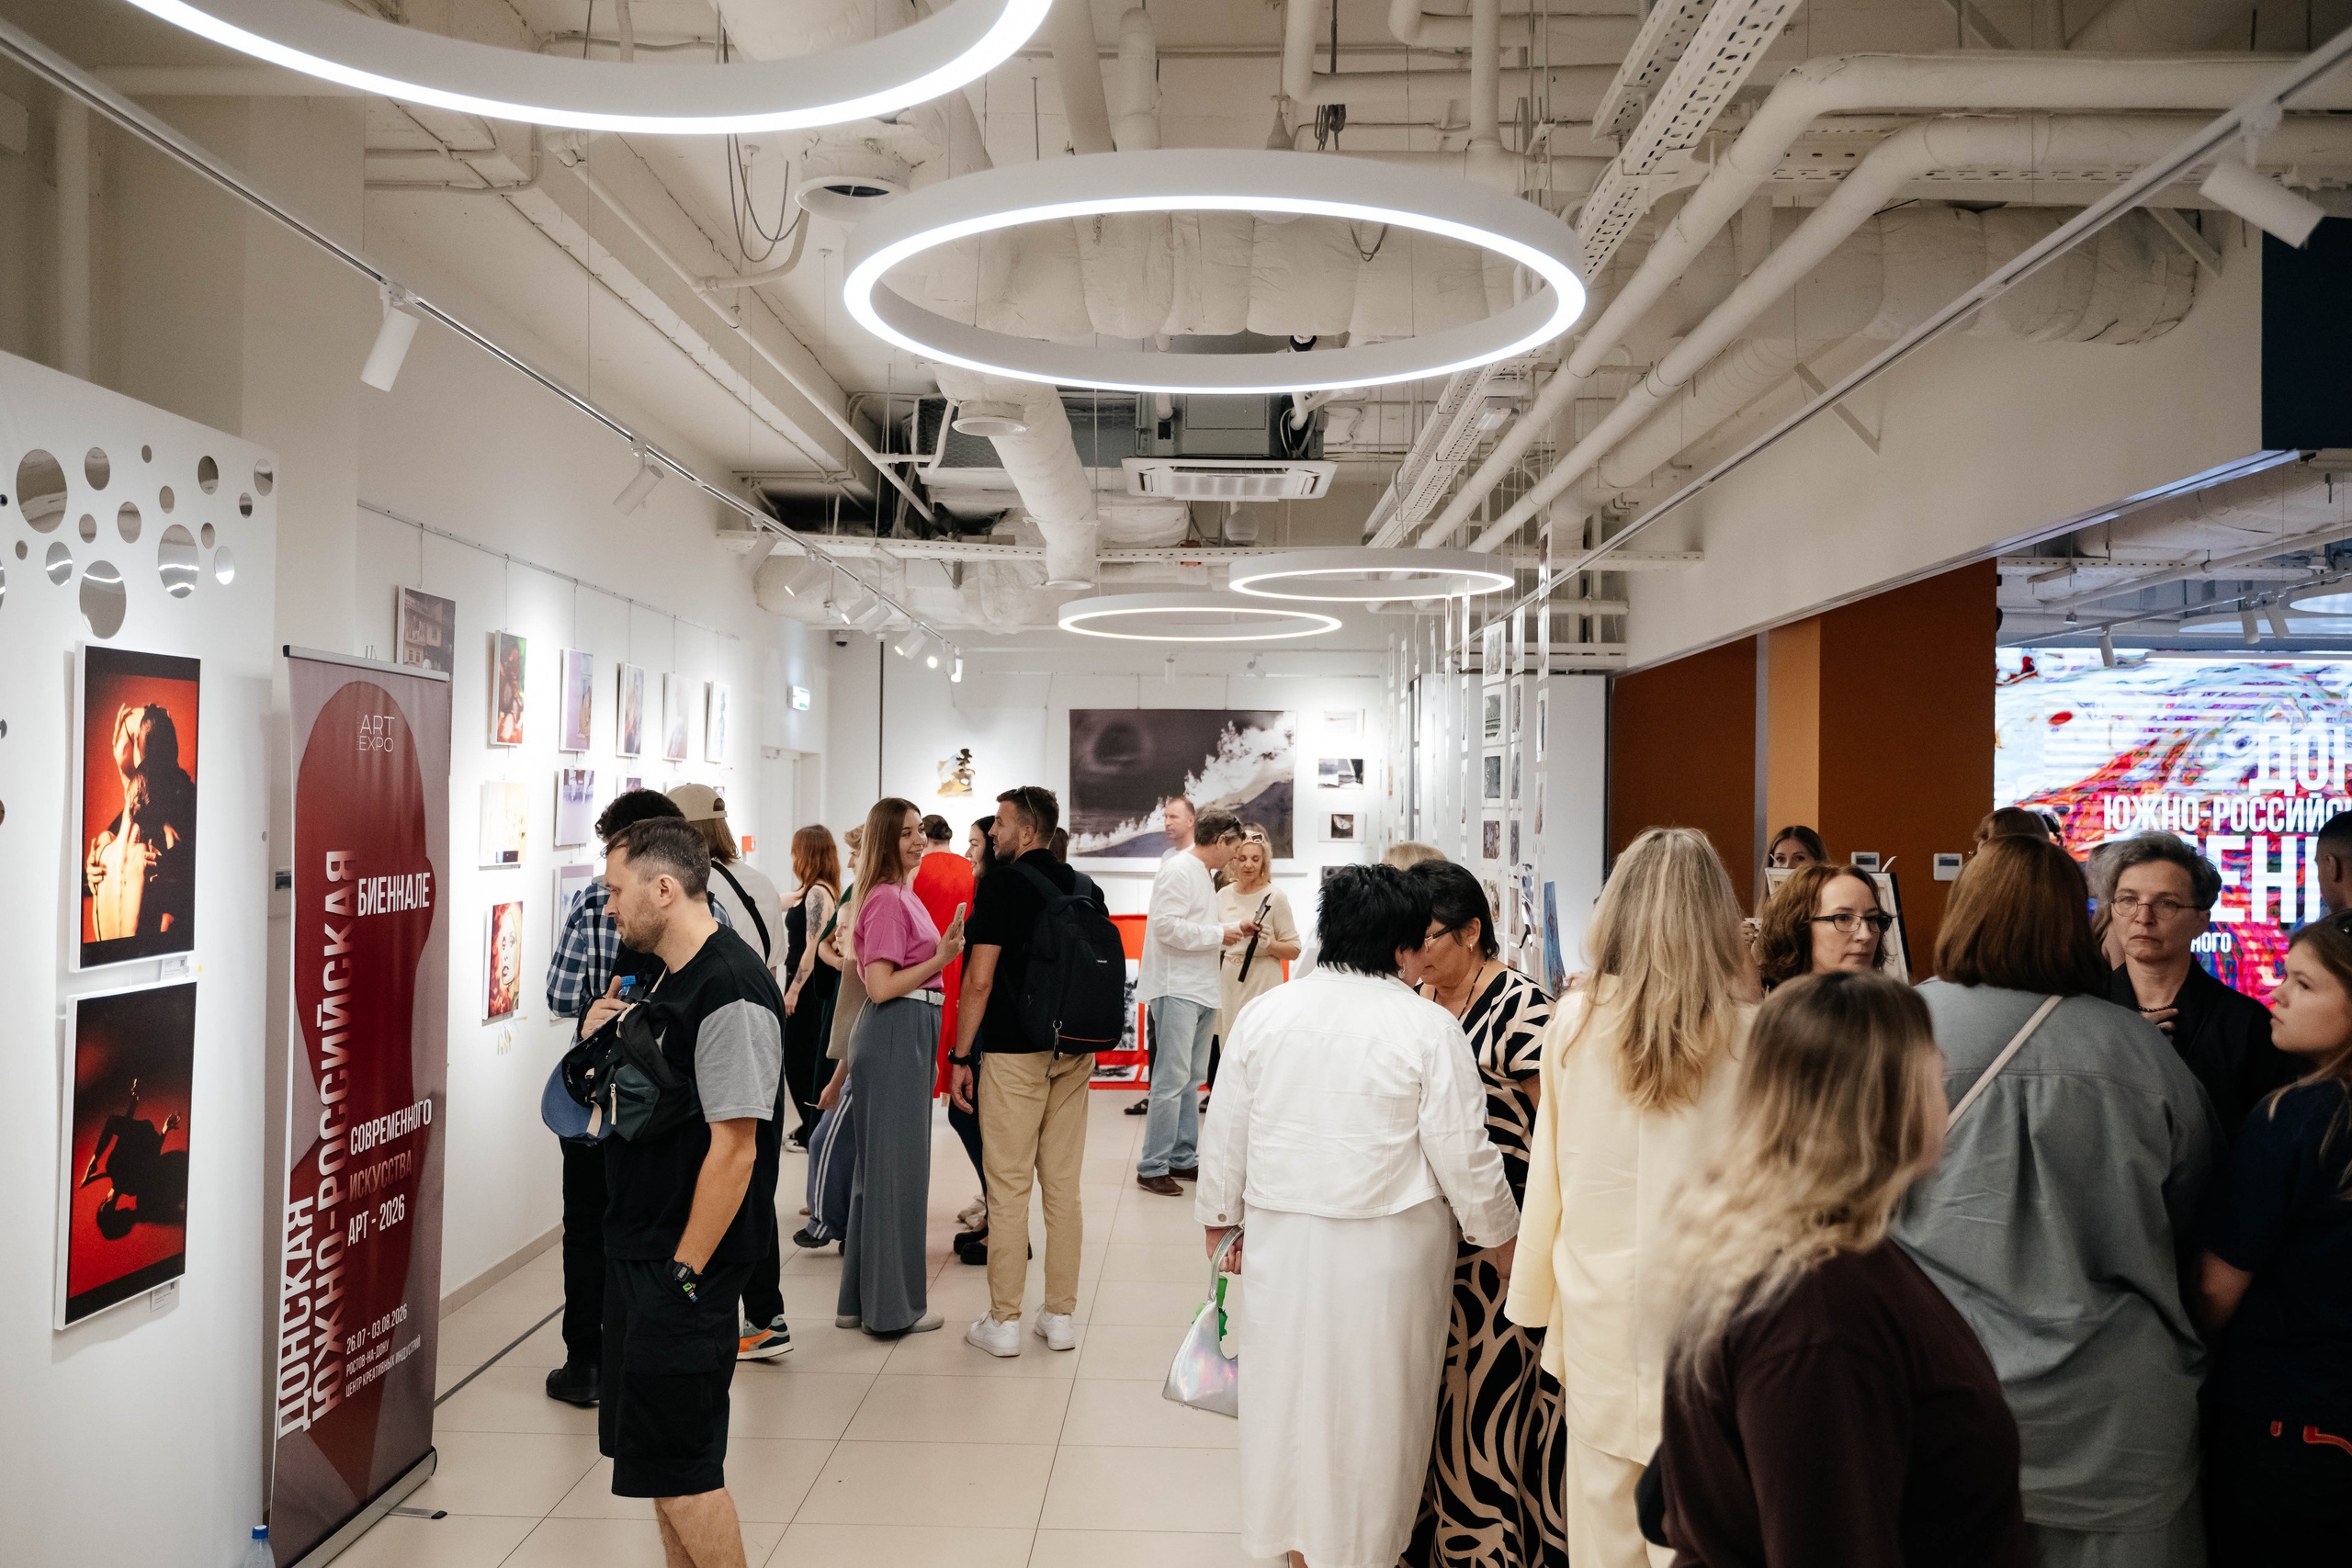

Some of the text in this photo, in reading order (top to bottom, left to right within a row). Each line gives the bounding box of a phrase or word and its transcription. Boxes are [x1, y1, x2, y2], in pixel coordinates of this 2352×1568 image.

[358, 735, 395, 752] EXPO
[359, 714, 396, 737] ART
[2103, 792, 2352, 832] ЮЖНО-РОССИЙС
[356, 872, 431, 918] БИЕННАЛЕ
[311, 850, 356, 1423] ЮЖНО-РОССИЙСКАЯ
[349, 1098, 433, 1156] СОВРЕМЕННОГО
[348, 1149, 413, 1202] ИСКУССТВА
[347, 1210, 369, 1247] АРТ
[379, 1193, 406, 1232] 2026
[277, 1196, 314, 1441] ДОНСКАЯ
[346, 1328, 366, 1354] 26.07
[371, 1304, 407, 1338] 03.08.2026
[345, 1338, 390, 1378] РОСТОВ-НА-ДОНУ
[345, 1335, 421, 1398] ЦЕНТР КРЕАТИВНЫХ ИНДУСТРИЙ
